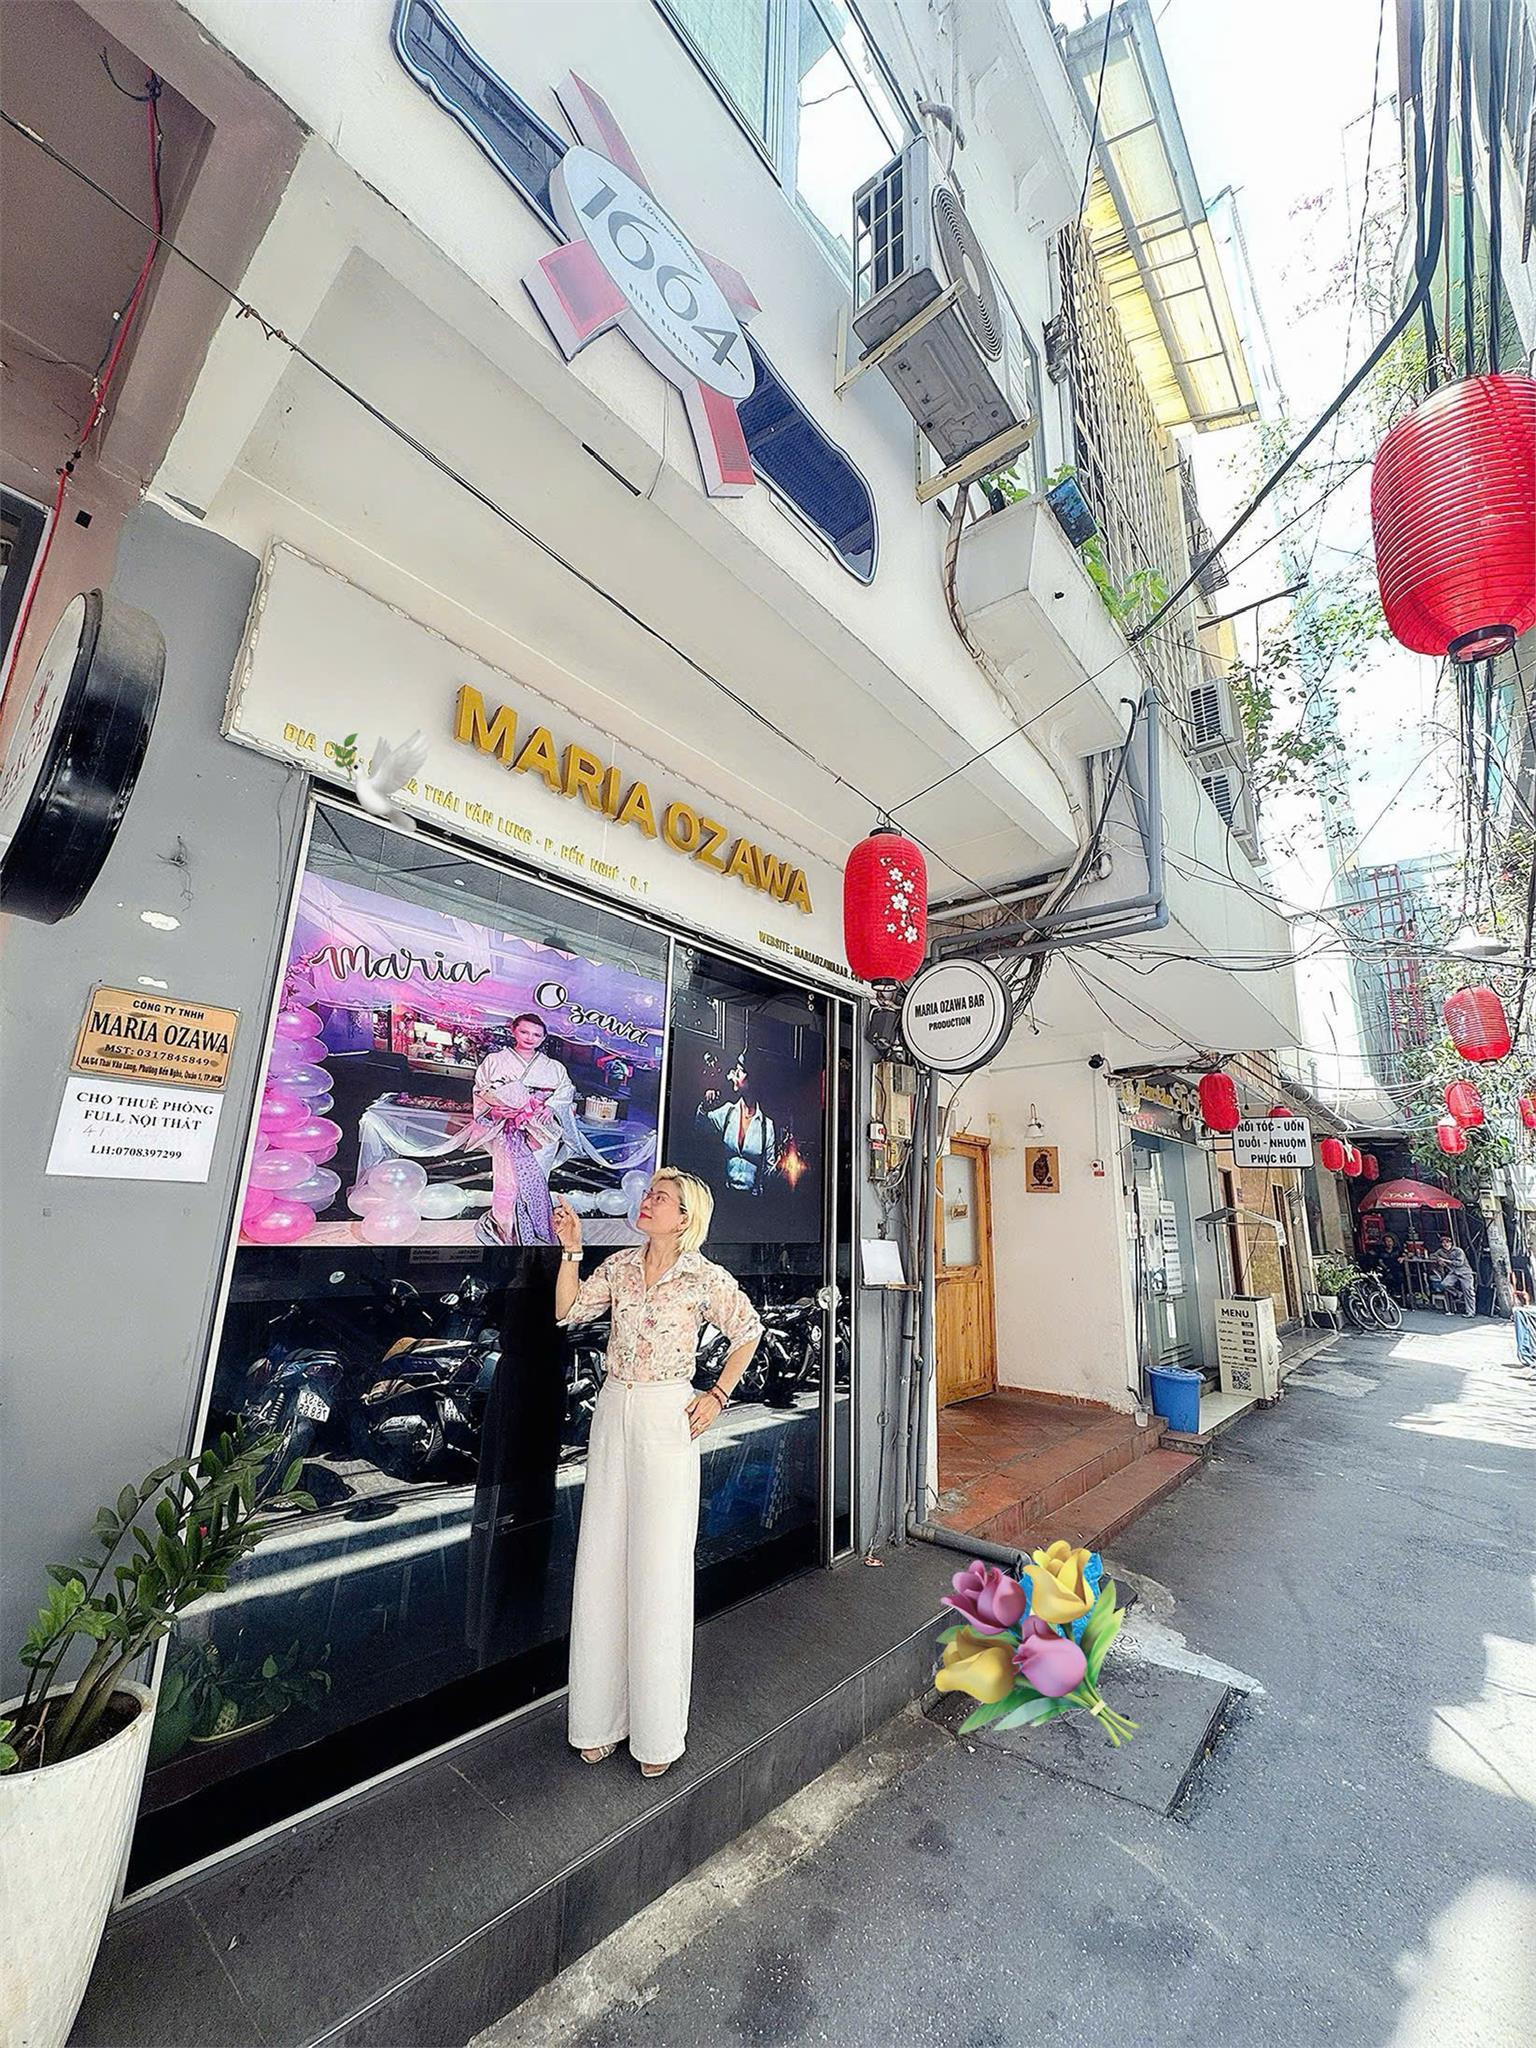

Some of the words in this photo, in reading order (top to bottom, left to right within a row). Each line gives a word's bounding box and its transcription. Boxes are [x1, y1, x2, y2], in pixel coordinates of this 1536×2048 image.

[581, 177, 745, 380] 1664
[284, 723, 317, 751] ĐỊA
[425, 784, 460, 812] THÁI
[465, 801, 493, 827] VĂN
[498, 817, 533, 844] LUNG
[454, 683, 658, 840] MARIA
[662, 801, 814, 914] OZAWA
[759, 931, 793, 955] WEBSITE:
[311, 945, 490, 984] Maria
[133, 1000, 160, 1013] CÔNG
[164, 1006, 176, 1014] TY
[179, 1009, 205, 1020] TNHH
[534, 982, 651, 1046] Ozawa
[914, 1001, 939, 1018] MARIA
[940, 997, 967, 1013] OZAWA
[968, 994, 985, 1008] BAR
[89, 1011, 158, 1042] MARIA
[164, 1025, 229, 1054] OZAWA
[928, 1016, 971, 1031] PRODUCTION
[104, 1044, 134, 1056] MST:
[136, 1048, 210, 1066] 0317845849
[76, 1092, 113, 1105] CHO
[117, 1096, 159, 1110] THUÊ
[162, 1100, 214, 1115] PHÒNG
[84, 1110, 125, 1123] FULL
[129, 1114, 157, 1128] NỘI
[1256, 1120, 1274, 1131] TÓC
[91, 1144, 182, 1160] LH:0708397299
[1251, 1154, 1277, 1165] PHỤC
[1221, 1308, 1249, 1318] MENU
